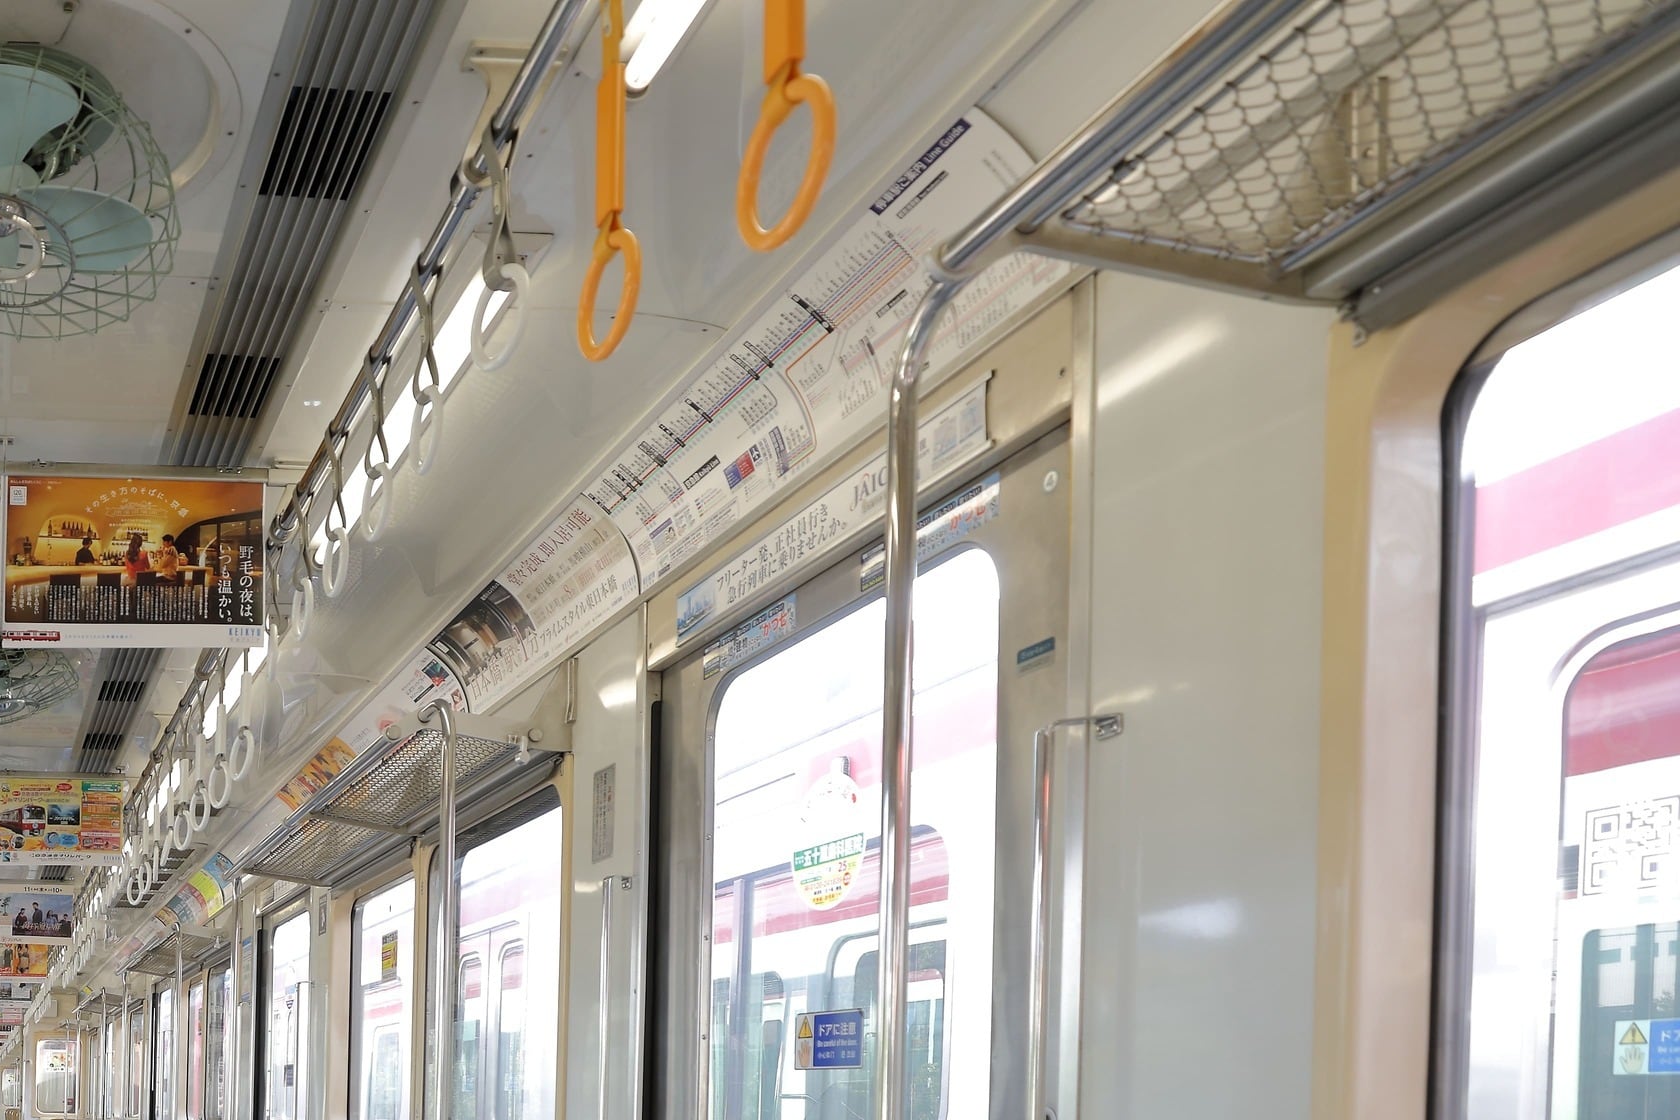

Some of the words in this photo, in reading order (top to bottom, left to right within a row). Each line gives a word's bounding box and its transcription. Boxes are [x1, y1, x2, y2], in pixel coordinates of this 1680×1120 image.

[923, 146, 943, 165] Line
[939, 123, 965, 148] Guide
[217, 543, 234, 623] いつも温かい。
[239, 545, 254, 623] 野毛の夜は、
[727, 517, 848, 605] 急行列車に乗りませんか。
[228, 627, 261, 637] KEIKYU
[818, 1021, 857, 1038] ドアに注意
